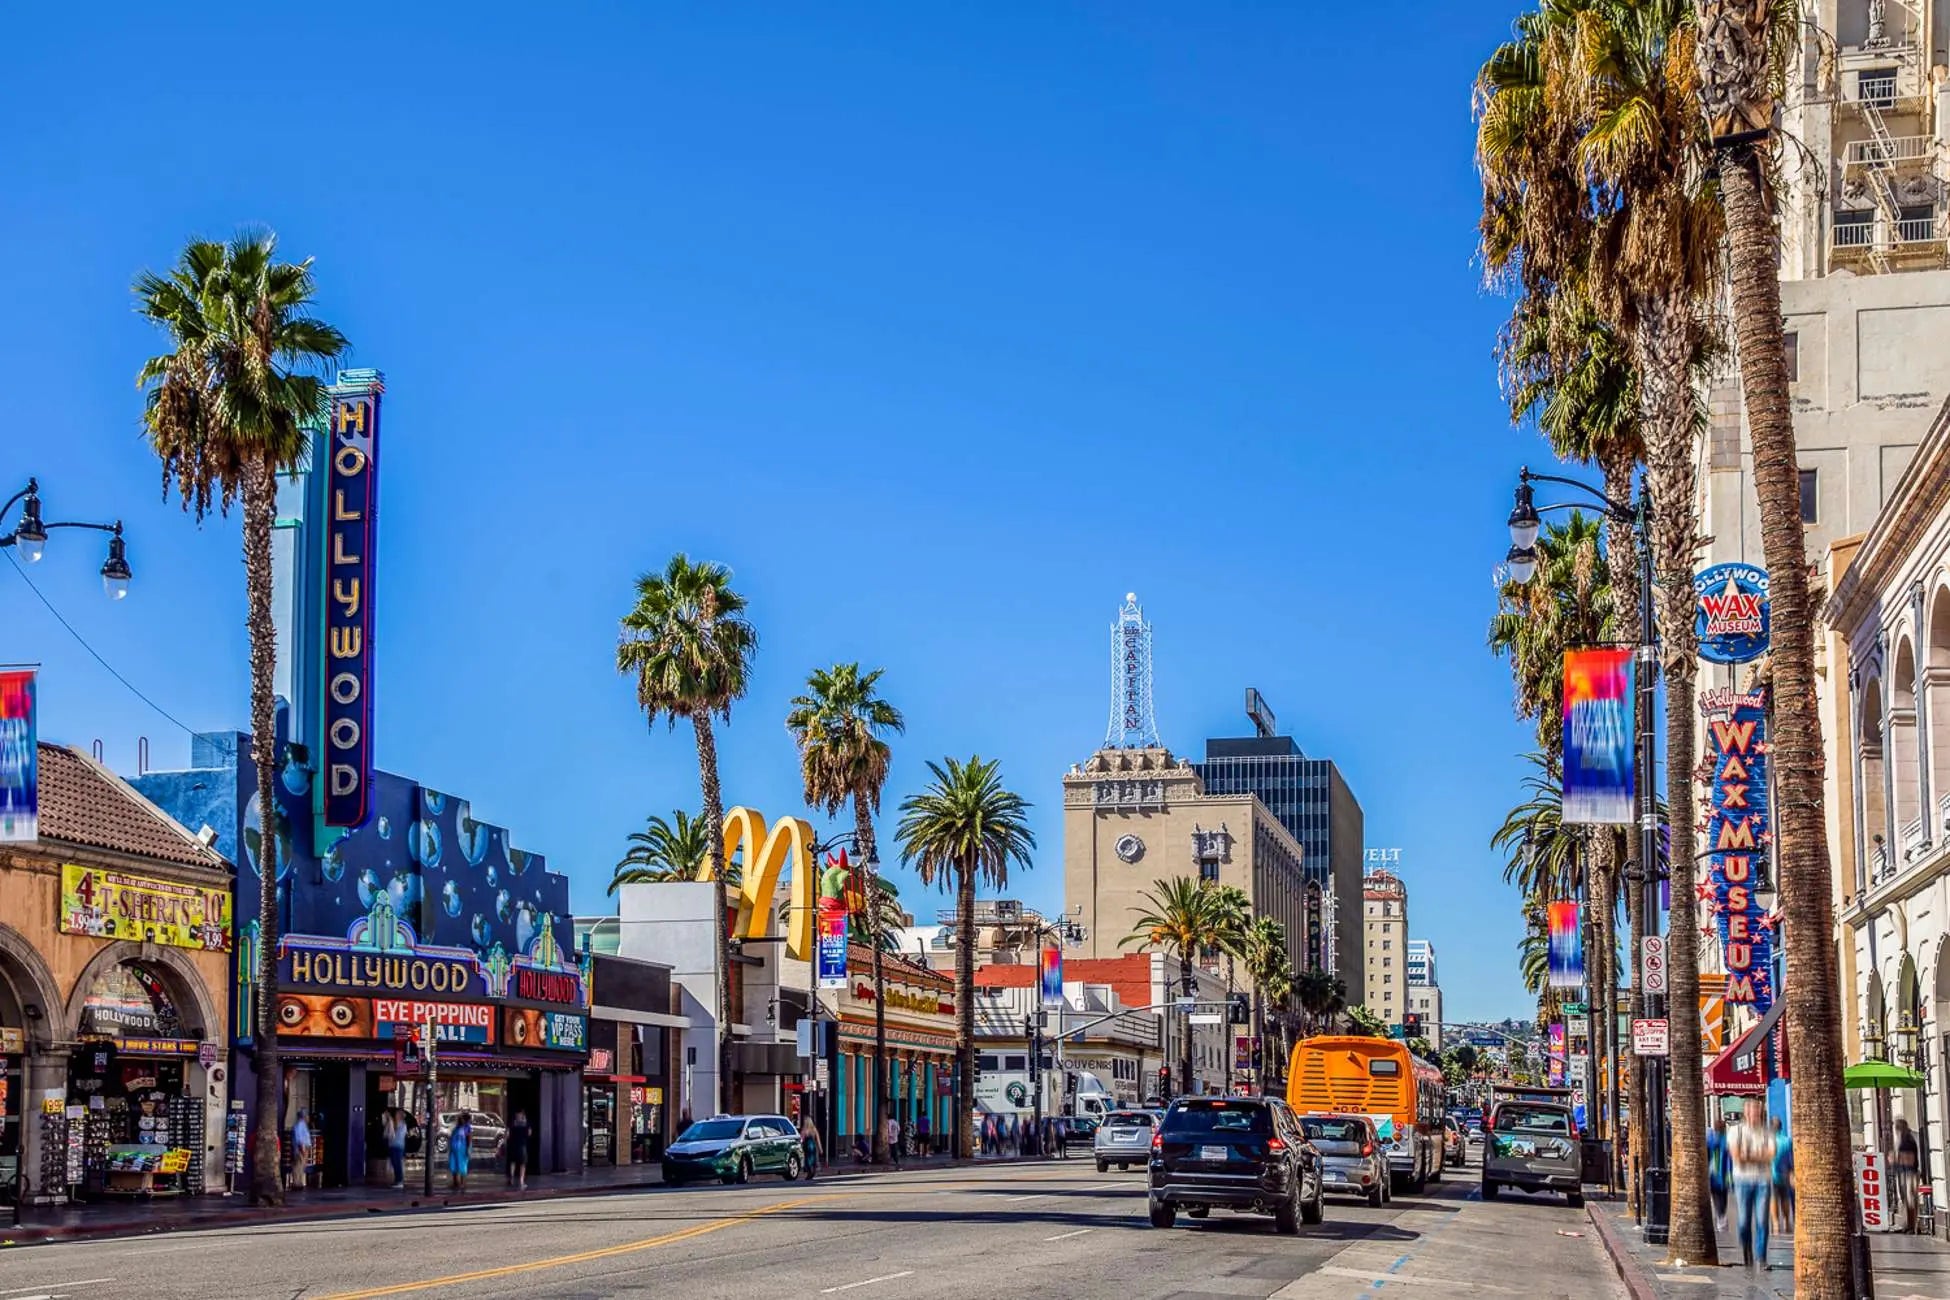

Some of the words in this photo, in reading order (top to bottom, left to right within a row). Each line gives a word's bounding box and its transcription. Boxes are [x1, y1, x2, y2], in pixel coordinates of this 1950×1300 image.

[331, 401, 366, 796] HOLLYWOOD
[1702, 593, 1762, 620] WAX
[1706, 620, 1762, 634] MUSEUM
[1124, 637, 1139, 729] CAPITAN
[1700, 687, 1765, 715] Hollywood
[1710, 720, 1757, 808] WAX
[75, 871, 96, 909] 4
[100, 887, 191, 927] T-SHIRTS
[1717, 816, 1757, 1004] MUSEUM
[291, 951, 469, 993] HOLLYWOOD
[519, 970, 577, 1004] HOLLYWOOD
[94, 1009, 150, 1028] HOLLYWOOD
[377, 1000, 409, 1021] EYE
[413, 1003, 489, 1025] POPPING
[551, 1022, 564, 1037] VIP
[564, 1023, 583, 1038] PASS
[1862, 1154, 1881, 1226] TOURS
